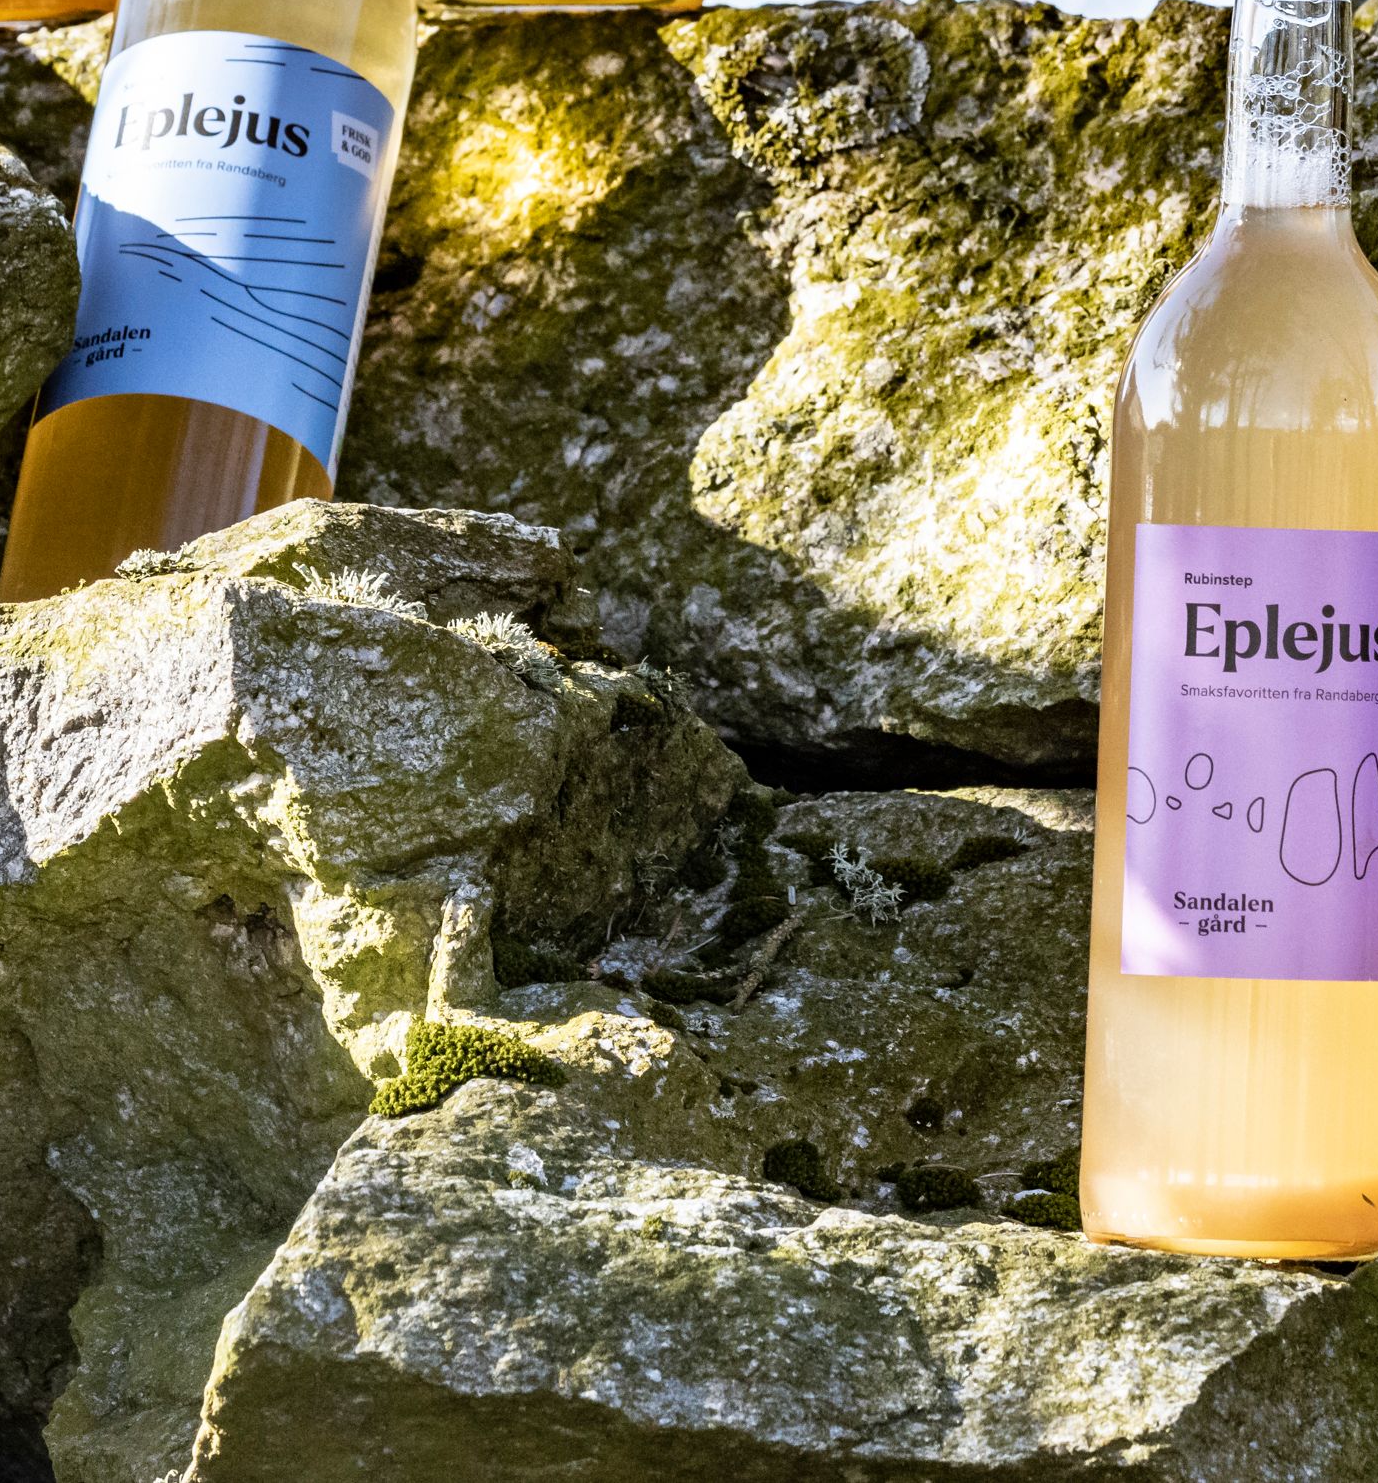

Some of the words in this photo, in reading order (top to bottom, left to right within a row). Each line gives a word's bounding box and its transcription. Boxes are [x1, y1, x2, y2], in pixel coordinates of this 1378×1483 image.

[342, 124, 371, 149] FRISK
[341, 139, 349, 153] &
[351, 144, 372, 164] GOD
[196, 158, 213, 171] fra
[216, 160, 287, 188] Randaberg
[72, 325, 151, 353] Sandalen
[85, 342, 125, 368] gård
[1184, 572, 1253, 588] Rubinstep
[1180, 684, 1290, 701] Smaksfavoritten
[1293, 686, 1312, 701] fra
[1173, 891, 1274, 913] Sandalen
[1197, 913, 1247, 937] gård
